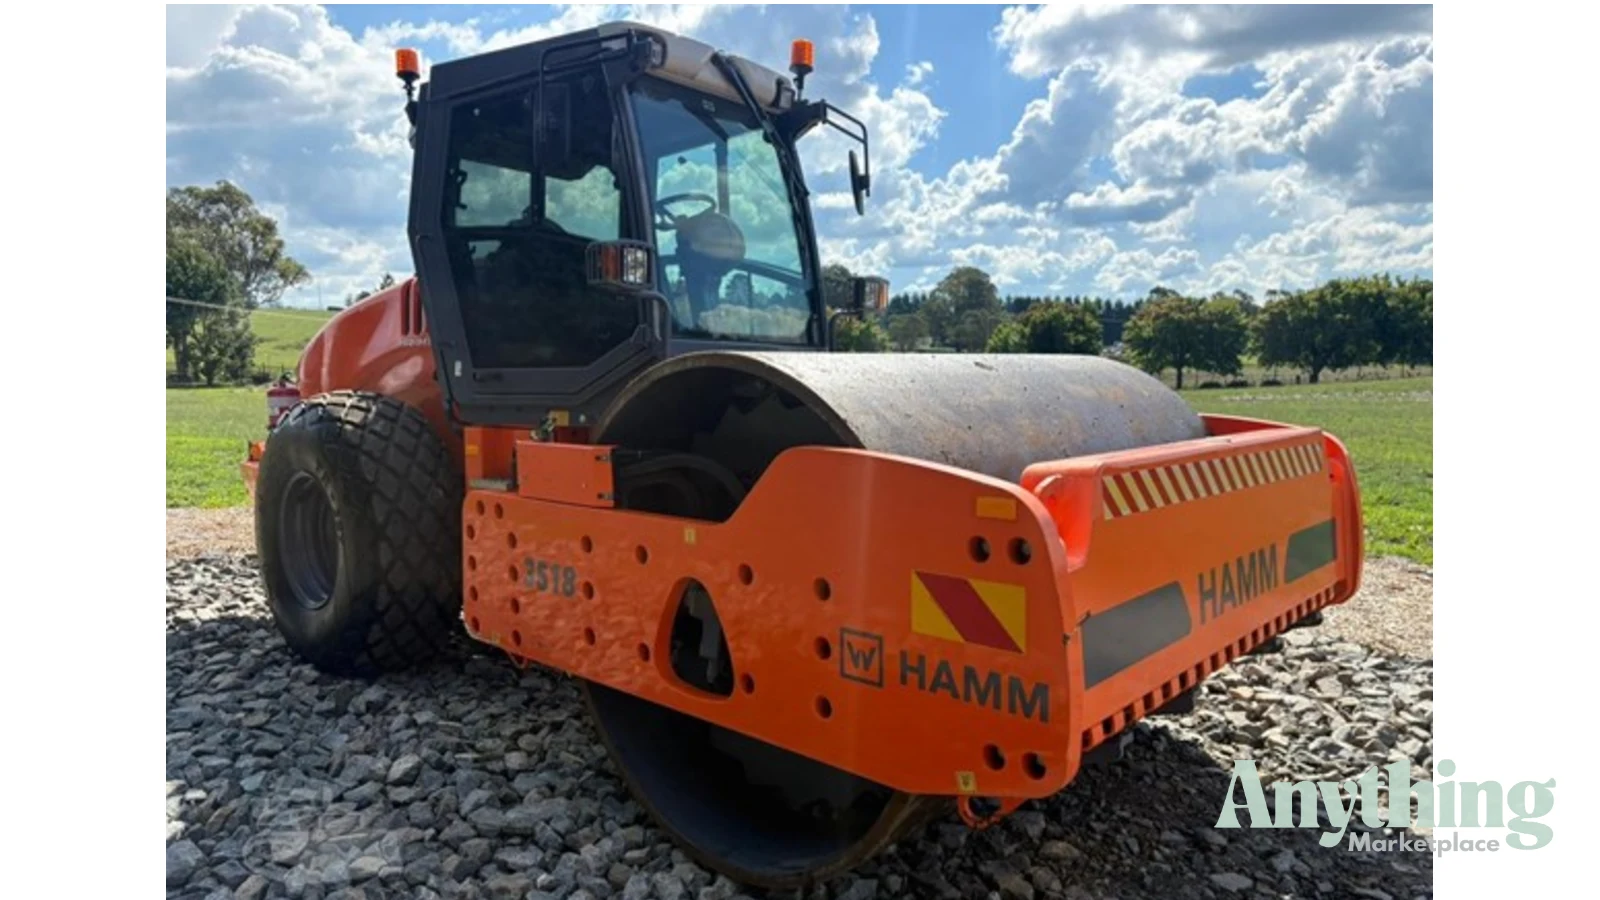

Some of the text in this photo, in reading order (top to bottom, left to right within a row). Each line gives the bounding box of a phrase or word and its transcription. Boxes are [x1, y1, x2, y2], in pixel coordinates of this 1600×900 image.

[524, 557, 576, 597] 3518
[1198, 543, 1277, 624] HAMM
[900, 651, 1049, 723] HAMM
